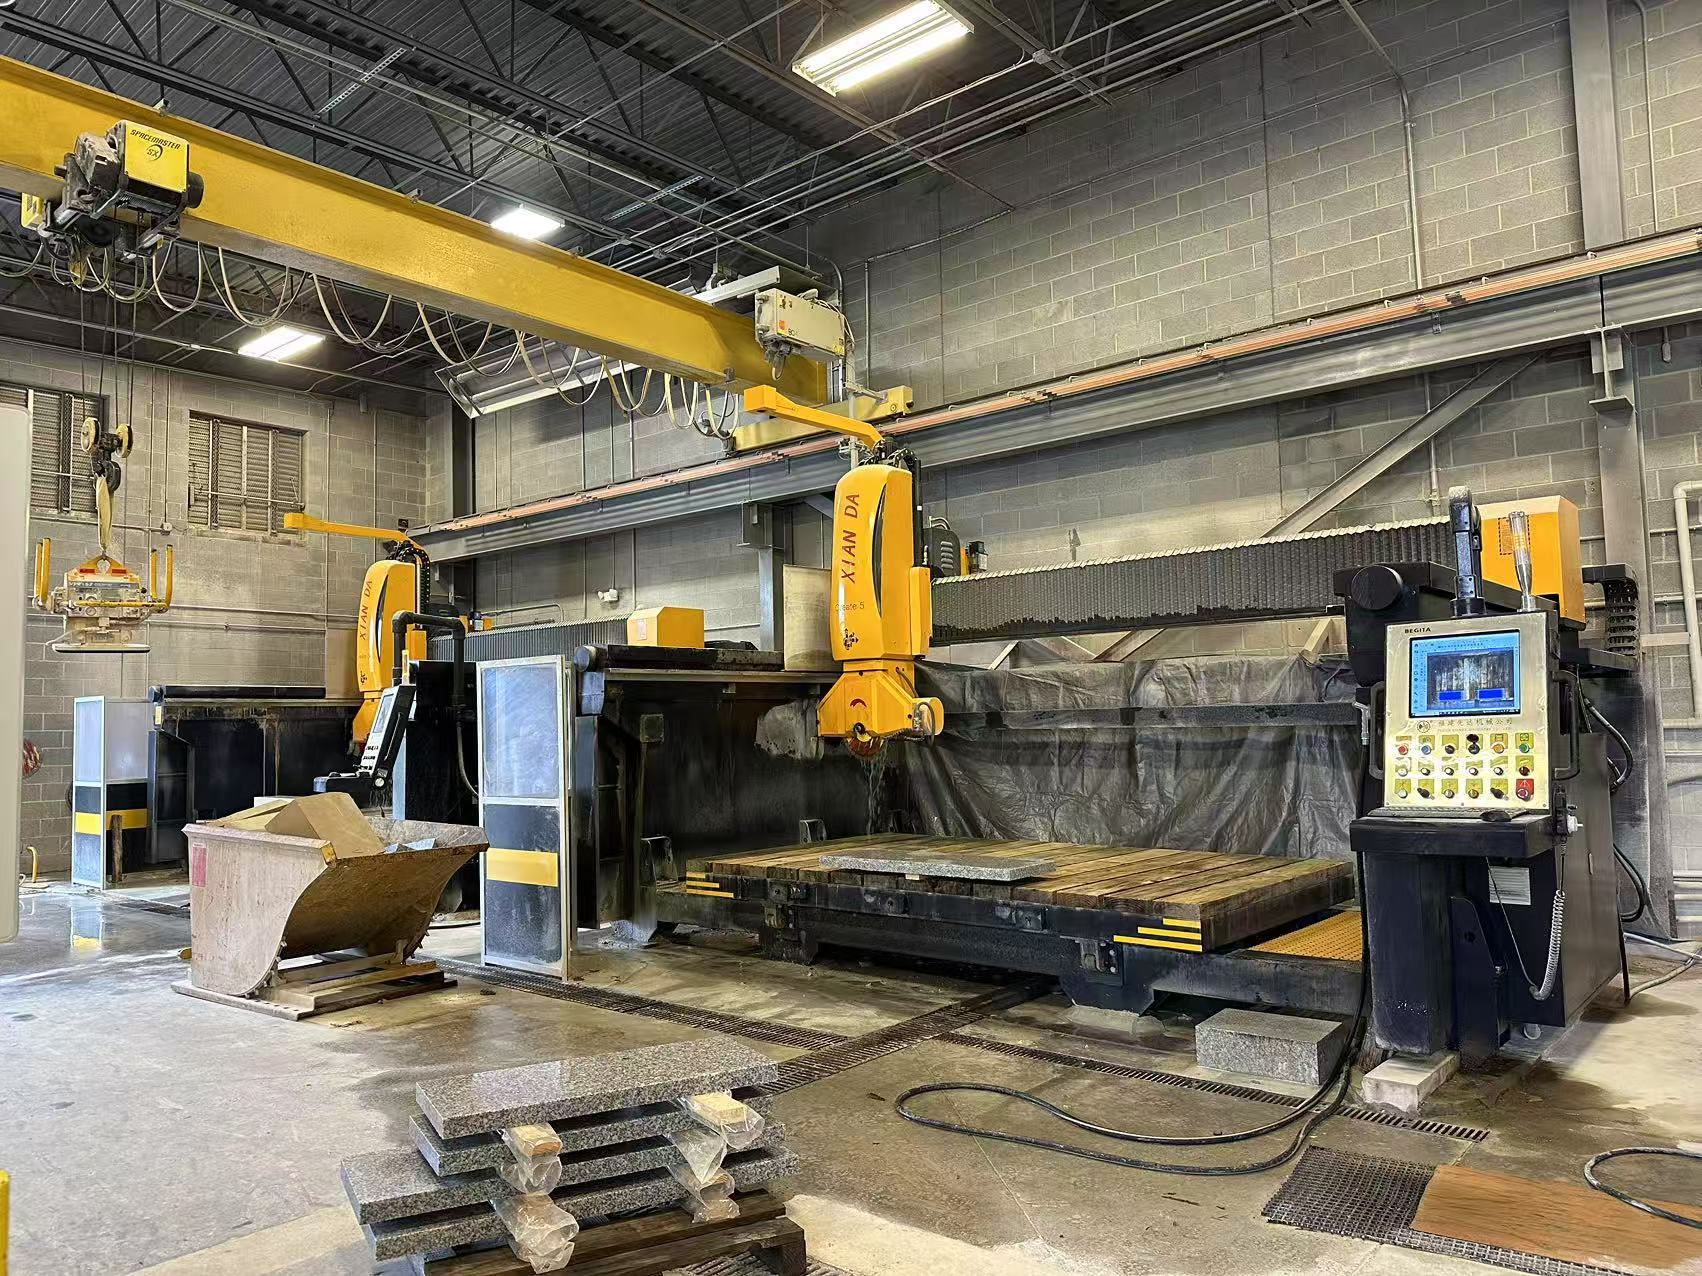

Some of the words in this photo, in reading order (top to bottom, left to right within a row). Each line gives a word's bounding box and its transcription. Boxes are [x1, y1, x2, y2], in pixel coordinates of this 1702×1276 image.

[130, 129, 181, 149] SPACEMASTER
[147, 149, 159, 157] SX
[844, 494, 860, 519] DA
[841, 530, 857, 584] XIAN
[835, 603, 857, 611] Ceate
[360, 606, 368, 640] XIAN
